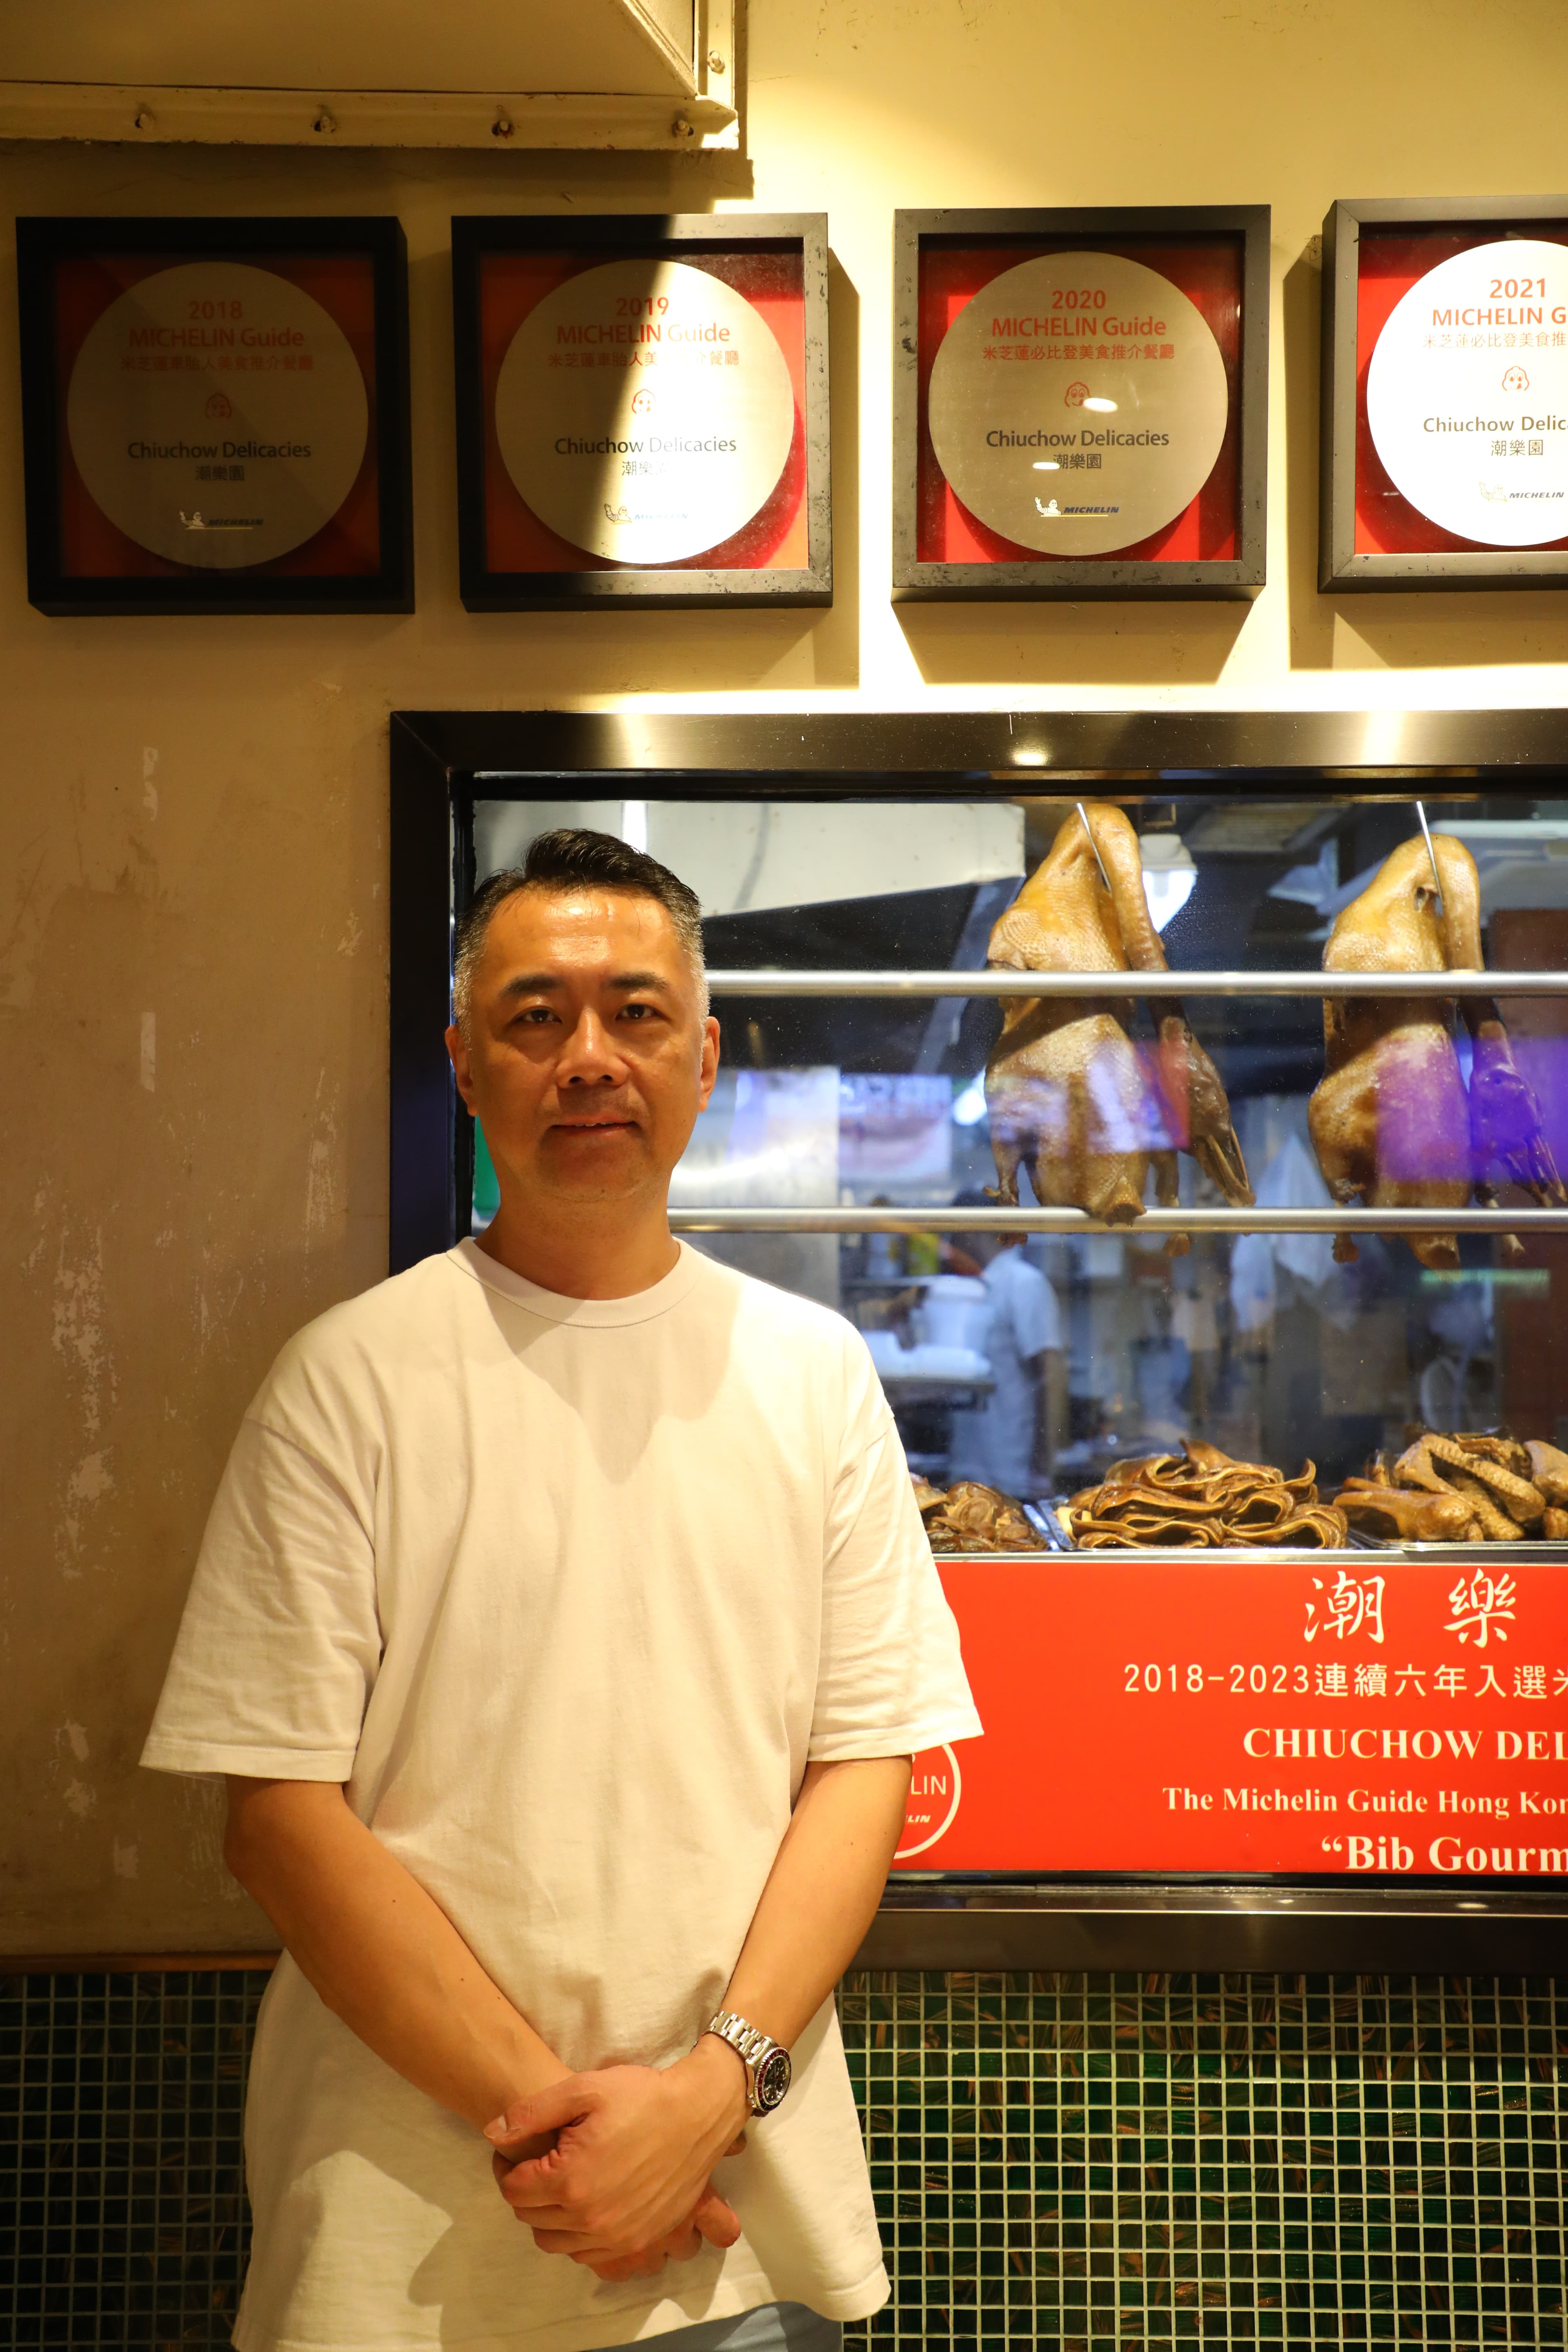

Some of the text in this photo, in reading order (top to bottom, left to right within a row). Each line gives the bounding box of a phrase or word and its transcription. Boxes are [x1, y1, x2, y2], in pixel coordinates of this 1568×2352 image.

[1490, 278, 1545, 298] 2021
[616, 297, 669, 316] 2019
[1051, 290, 1106, 310] 2020
[188, 300, 243, 321] 2018
[1433, 307, 1543, 326] MICHELIN
[557, 323, 731, 344] MICHELIN Guide
[992, 316, 1167, 337] MICHELIN Guide
[129, 327, 305, 347] MICHELIN Guide
[982, 343, 1174, 361] 米芝蓮必比登美食推介餐廳
[1423, 415, 1568, 432] Chiuchow Delic
[555, 436, 737, 454] Chiuchow Delicacies
[986, 429, 1169, 447] Chiuchow Delicacies
[127, 441, 312, 459] Chiuchow Delicacies
[1491, 439, 1544, 457] 潮樂園
[195, 464, 245, 481] 潮樂園
[208, 518, 264, 526] MICHELIN
[1243, 1728, 1483, 1759] CHIUCHOW
[1163, 1788, 1213, 1811] The
[1223, 1788, 1337, 1811] Michelin
[1348, 1789, 1428, 1813] Guide
[1438, 1791, 1510, 1819] Hong
